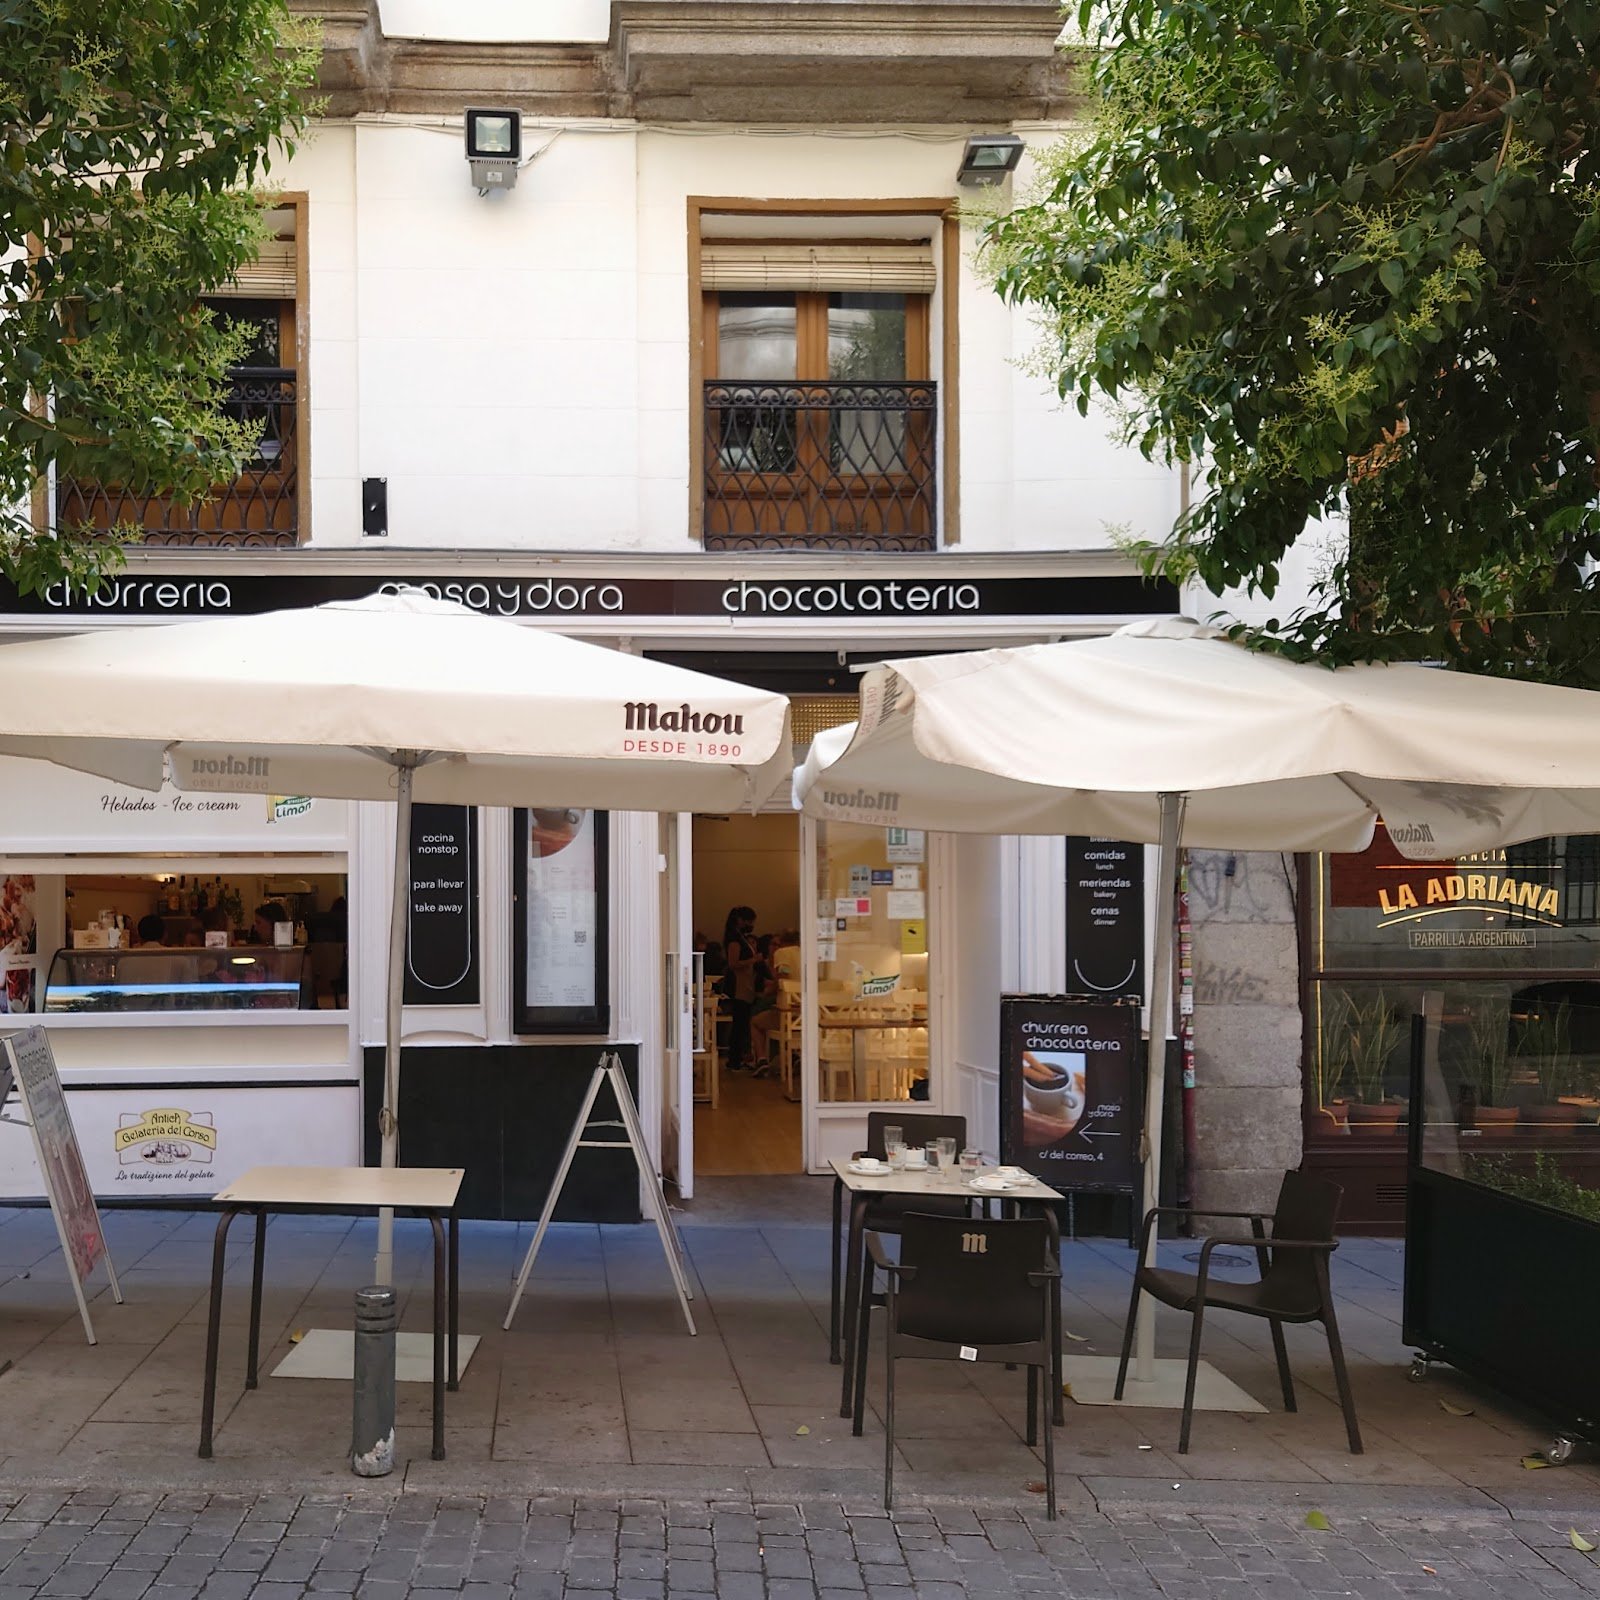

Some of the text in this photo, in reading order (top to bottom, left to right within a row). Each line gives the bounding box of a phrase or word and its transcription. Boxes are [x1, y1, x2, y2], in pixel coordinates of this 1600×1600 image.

[46, 576, 231, 607] churreria
[722, 581, 980, 611] chocolateria
[623, 740, 742, 757] DESDE 1890
[100, 794, 157, 813] Helados
[172, 795, 194, 811] Ice
[197, 800, 240, 811] cream
[422, 833, 455, 843] cocina
[418, 845, 459, 856] nonstop
[1084, 850, 1126, 860] comidas
[413, 878, 465, 891] para llevar
[1079, 878, 1132, 888] meriendas
[1093, 891, 1117, 899] bakery
[1378, 874, 1559, 916] LA ADRIANA
[415, 902, 463, 914] take away
[1090, 907, 1120, 916] cenas
[1093, 918, 1117, 926] dinner
[1414, 931, 1528, 946] PARRILLA ARGENTINA
[1021, 1021, 1089, 1035] churreria
[1026, 1036, 1121, 1051] chocolateria
[122, 1125, 210, 1143] Gelateria del Corso
[1049, 1150, 1064, 1160] del
[1096, 1152, 1104, 1161] 4
[115, 1169, 216, 1182] La tradizione del gelato
